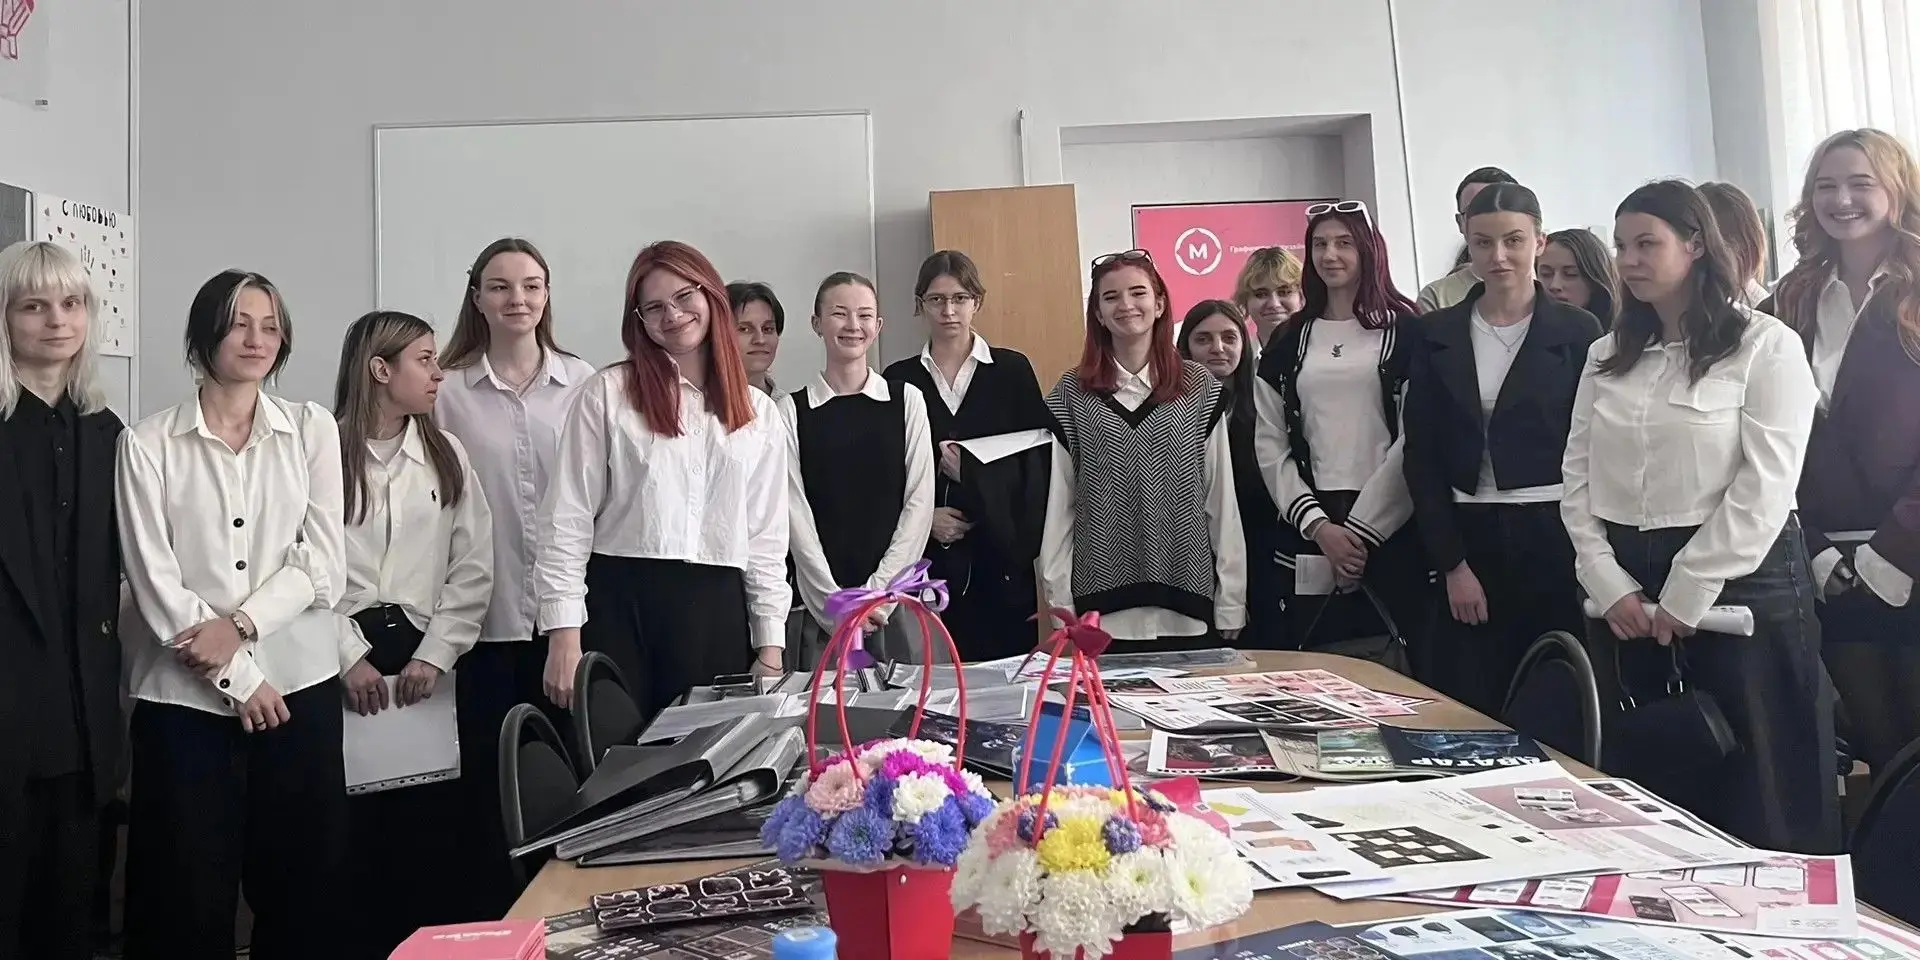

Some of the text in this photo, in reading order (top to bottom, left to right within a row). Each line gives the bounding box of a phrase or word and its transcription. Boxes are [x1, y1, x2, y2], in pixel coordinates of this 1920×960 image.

[62, 199, 116, 229] С ЛЮБОВЬЮ
[1410, 756, 1541, 767] АВАТАР
